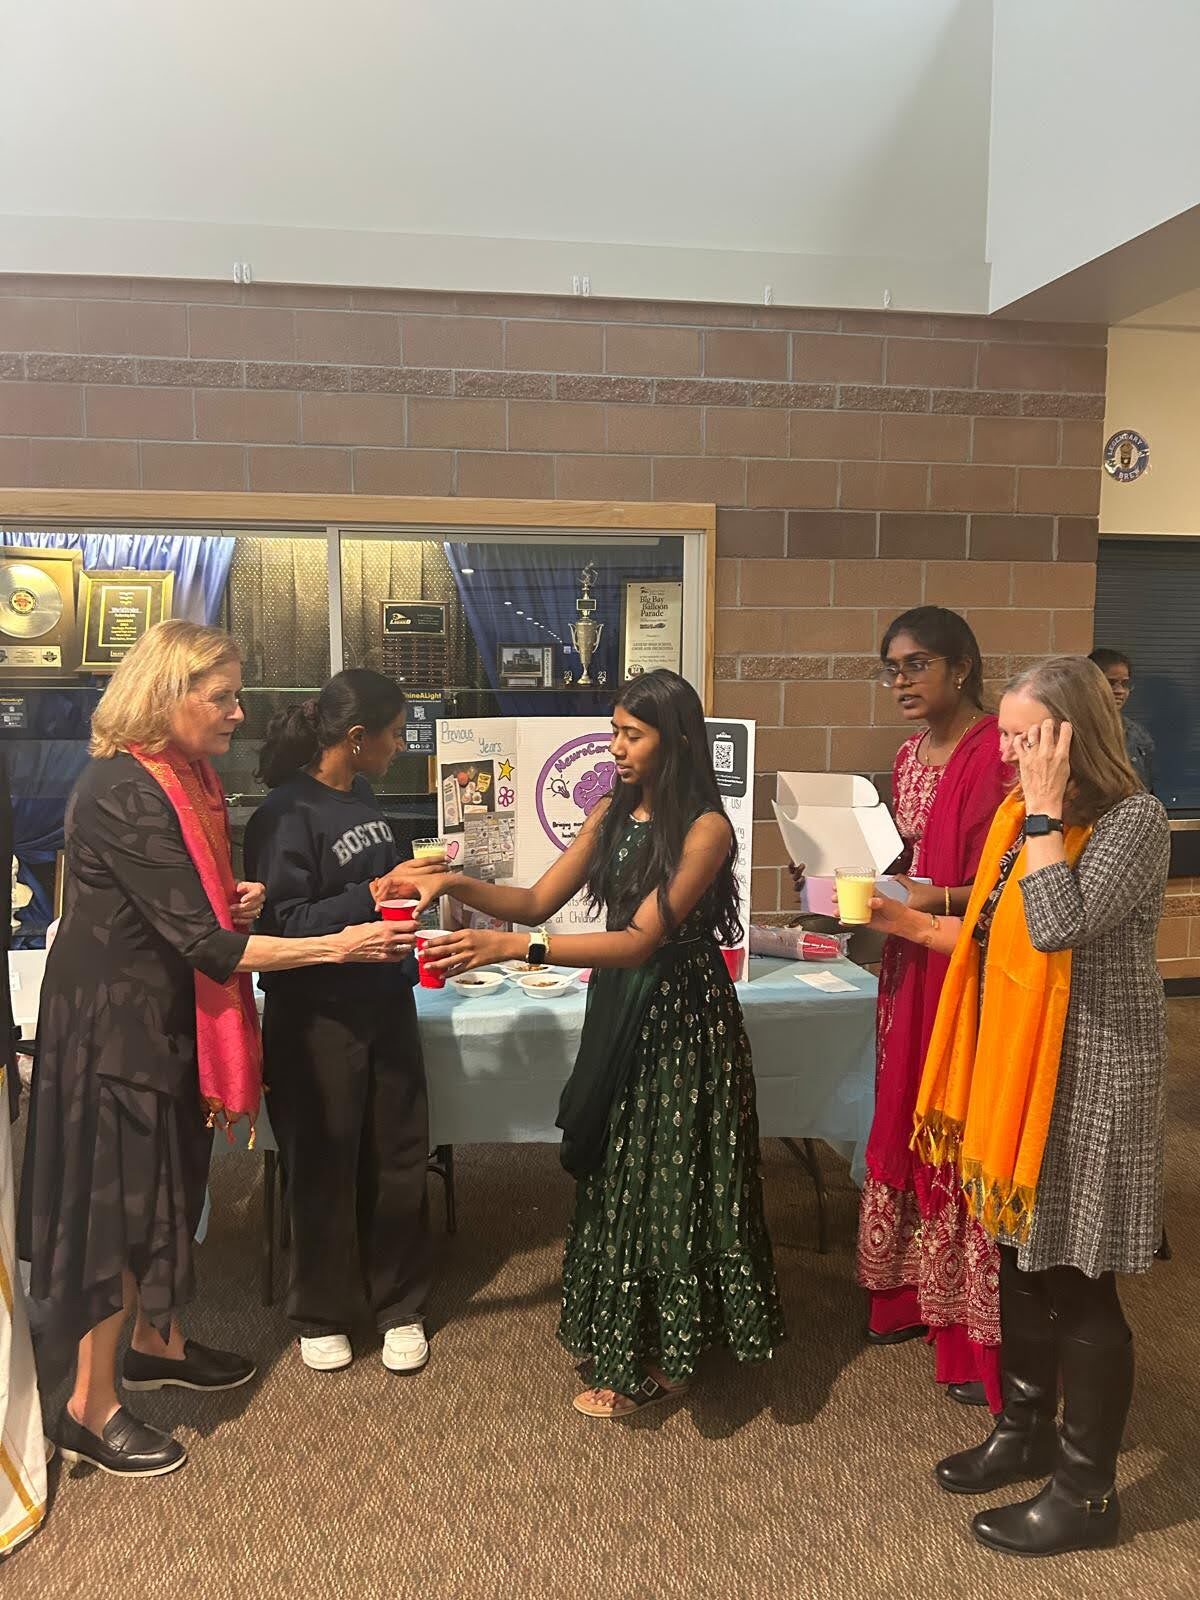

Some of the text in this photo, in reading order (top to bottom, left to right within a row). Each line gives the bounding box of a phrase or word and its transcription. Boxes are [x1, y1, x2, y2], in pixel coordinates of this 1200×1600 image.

[652, 595, 664, 604] Bay
[441, 721, 473, 740] Previous
[554, 742, 610, 773] NeuroCar
[332, 820, 393, 867] BOSTO
